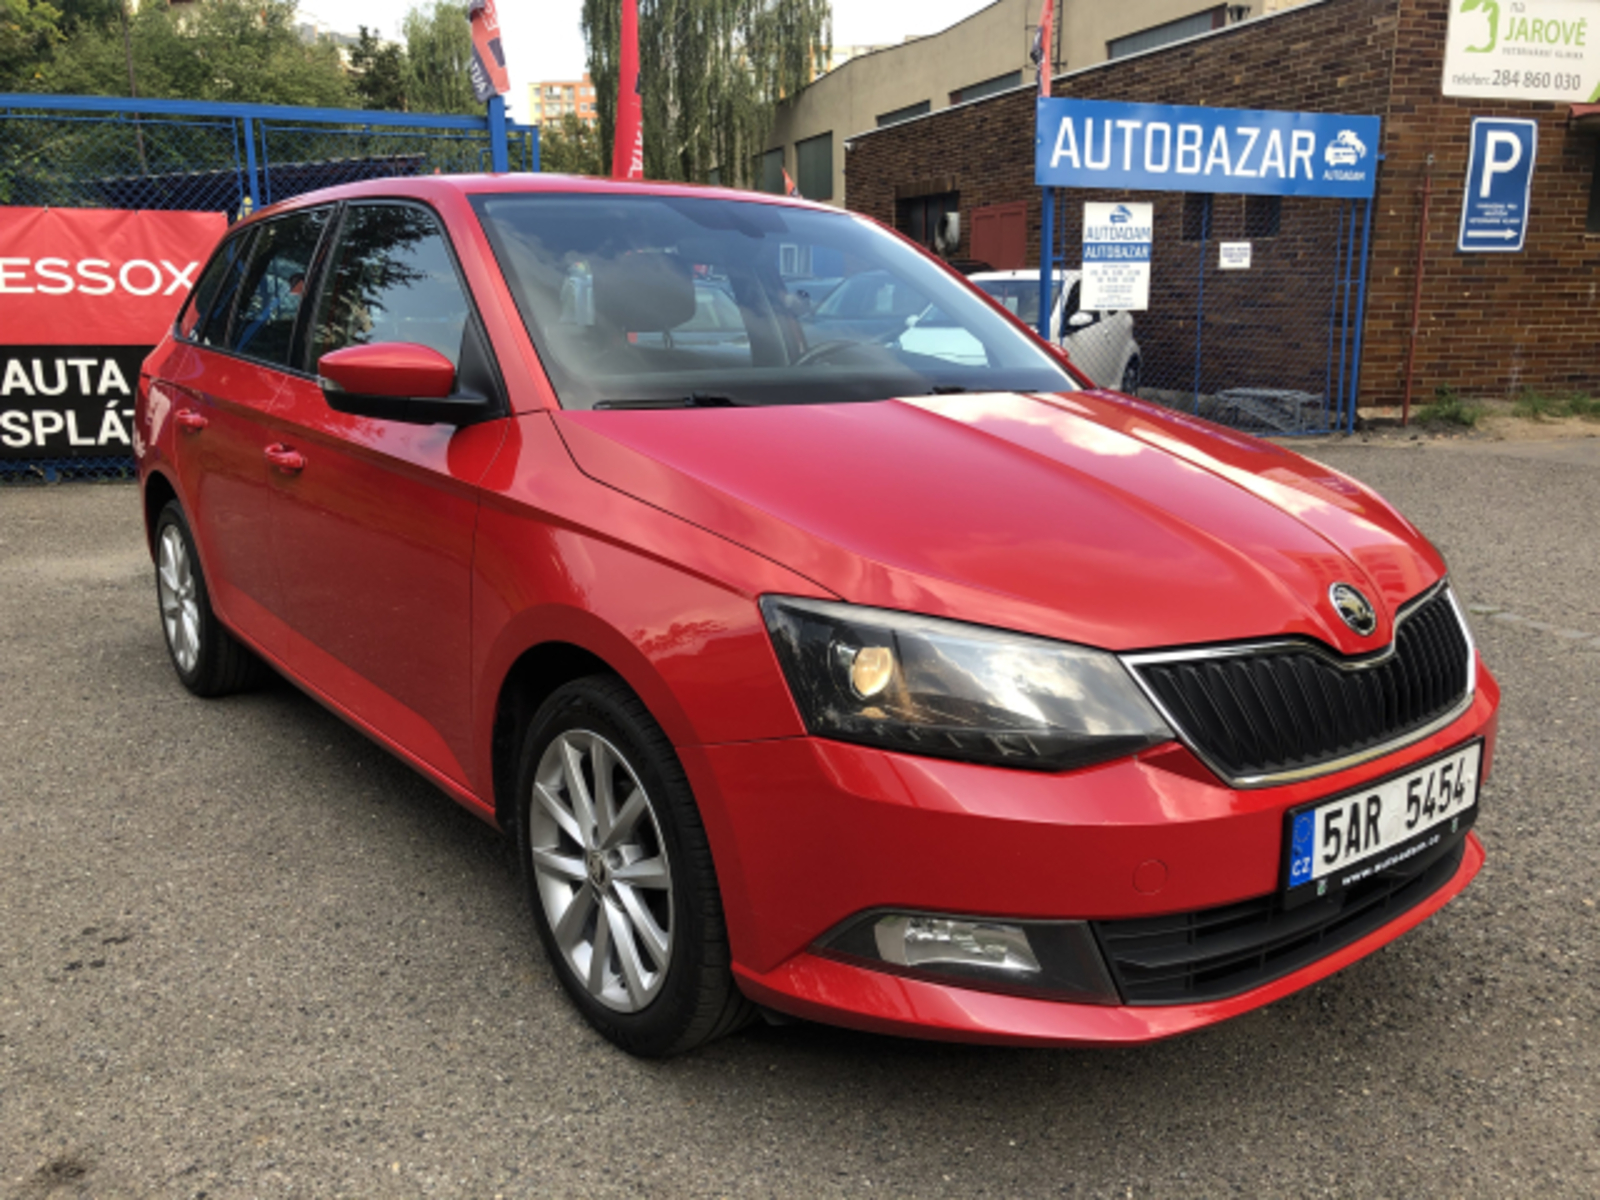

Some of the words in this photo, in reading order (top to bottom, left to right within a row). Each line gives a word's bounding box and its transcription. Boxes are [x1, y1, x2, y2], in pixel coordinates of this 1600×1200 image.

[1492, 69, 1520, 88] 284
[1523, 72, 1551, 89] 860
[1554, 73, 1581, 91] 030
[1050, 116, 1316, 181] AUTOBAZAR
[1480, 130, 1522, 197] P
[1085, 244, 1149, 259] AUTOBAZAR
[0, 257, 200, 296] ESSOX
[0, 358, 131, 396] AUTA
[1322, 794, 1382, 865] 5AR
[1405, 756, 1466, 830] 5454
[1292, 857, 1311, 876] CZ
